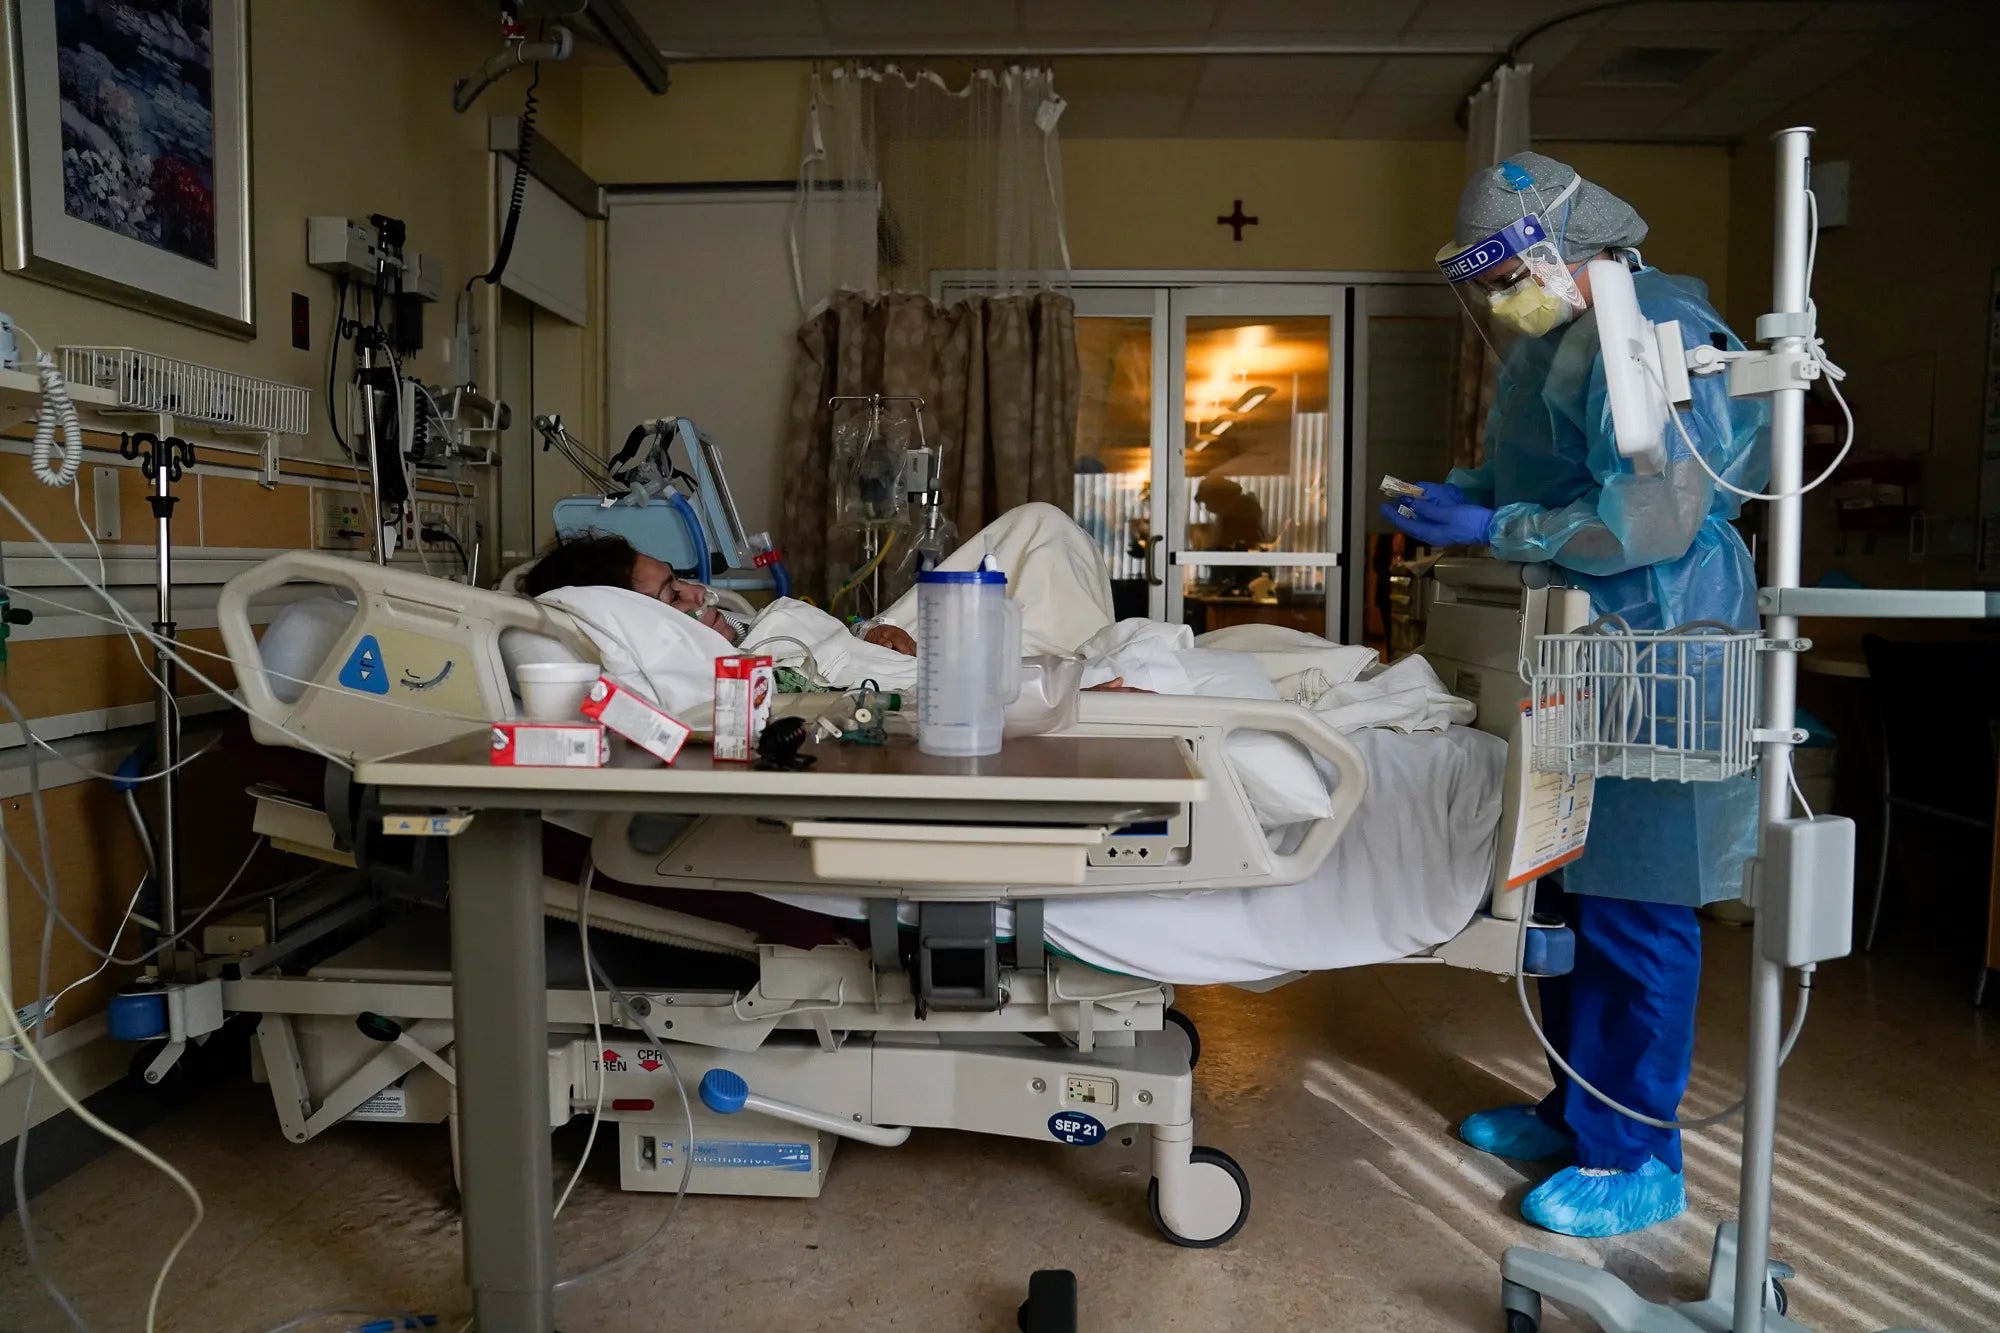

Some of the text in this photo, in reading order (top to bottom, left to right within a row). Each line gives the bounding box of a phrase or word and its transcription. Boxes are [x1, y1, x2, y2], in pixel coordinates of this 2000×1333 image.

[1443, 250, 1489, 278] SHIELD
[1055, 1119, 1097, 1137] SEP 21
